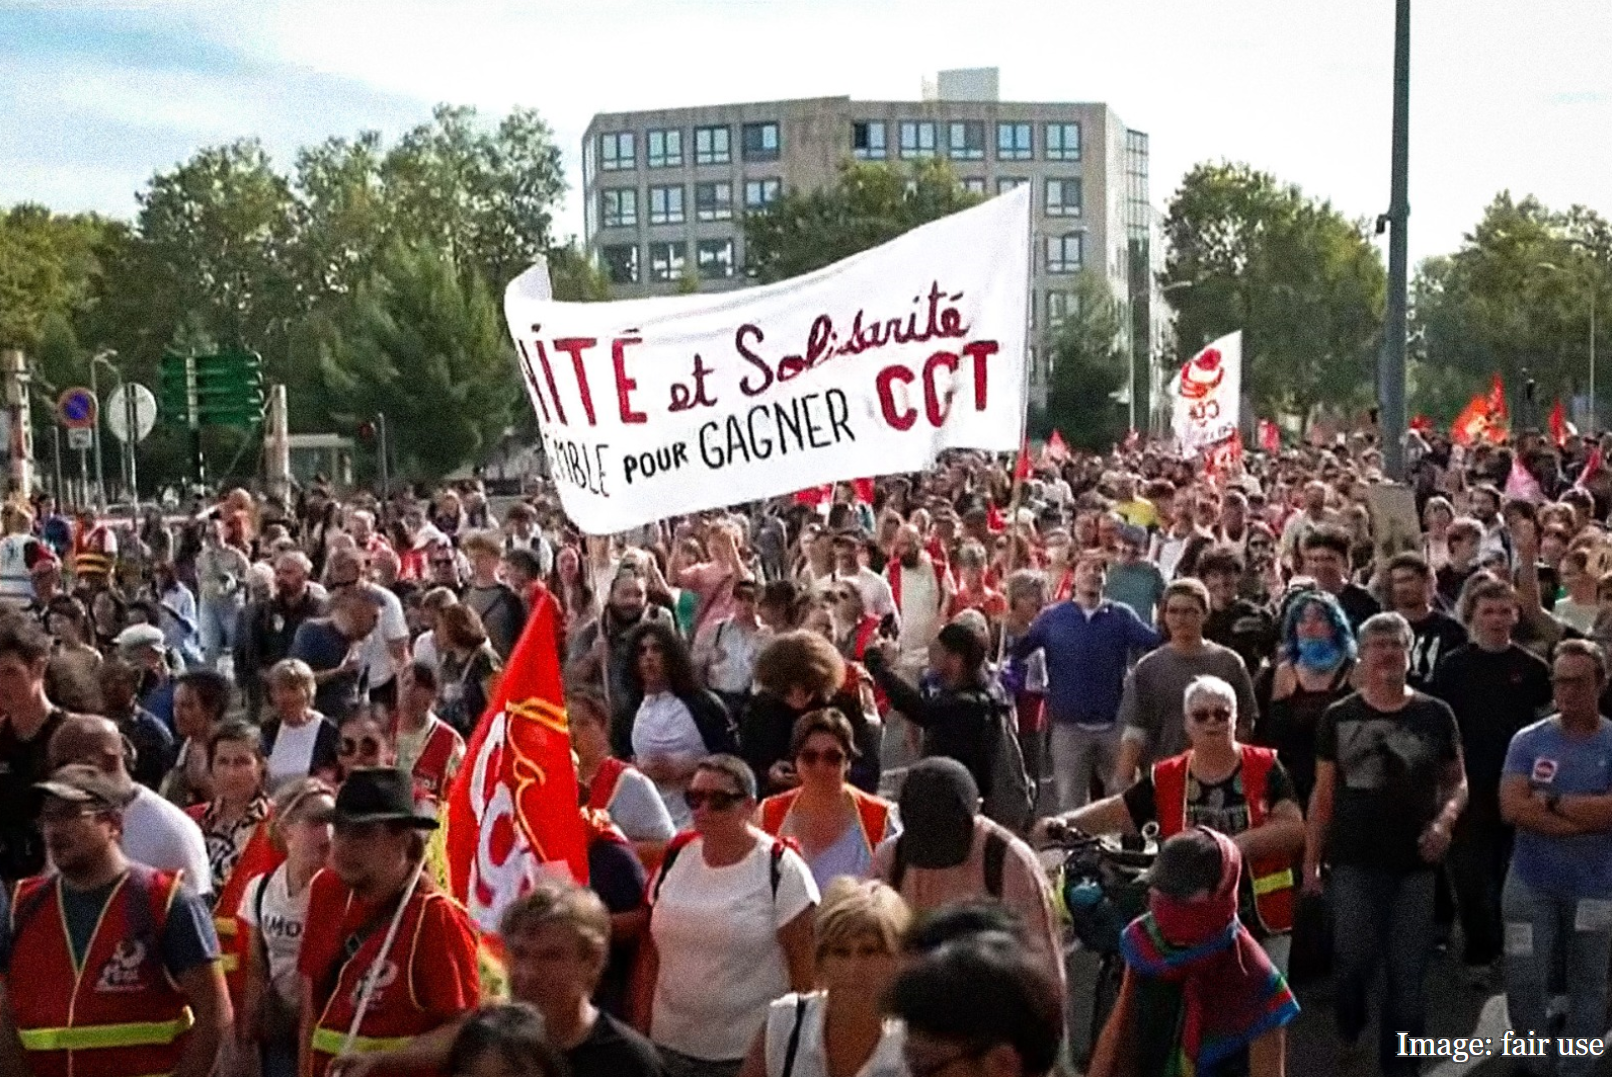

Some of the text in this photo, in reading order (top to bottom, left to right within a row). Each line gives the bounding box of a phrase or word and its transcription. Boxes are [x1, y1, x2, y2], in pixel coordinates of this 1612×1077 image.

[668, 353, 718, 412] et
[735, 280, 970, 396] Solidarité
[544, 433, 610, 498] MBLE
[623, 442, 689, 485] POUR
[699, 388, 855, 470] GAGNER
